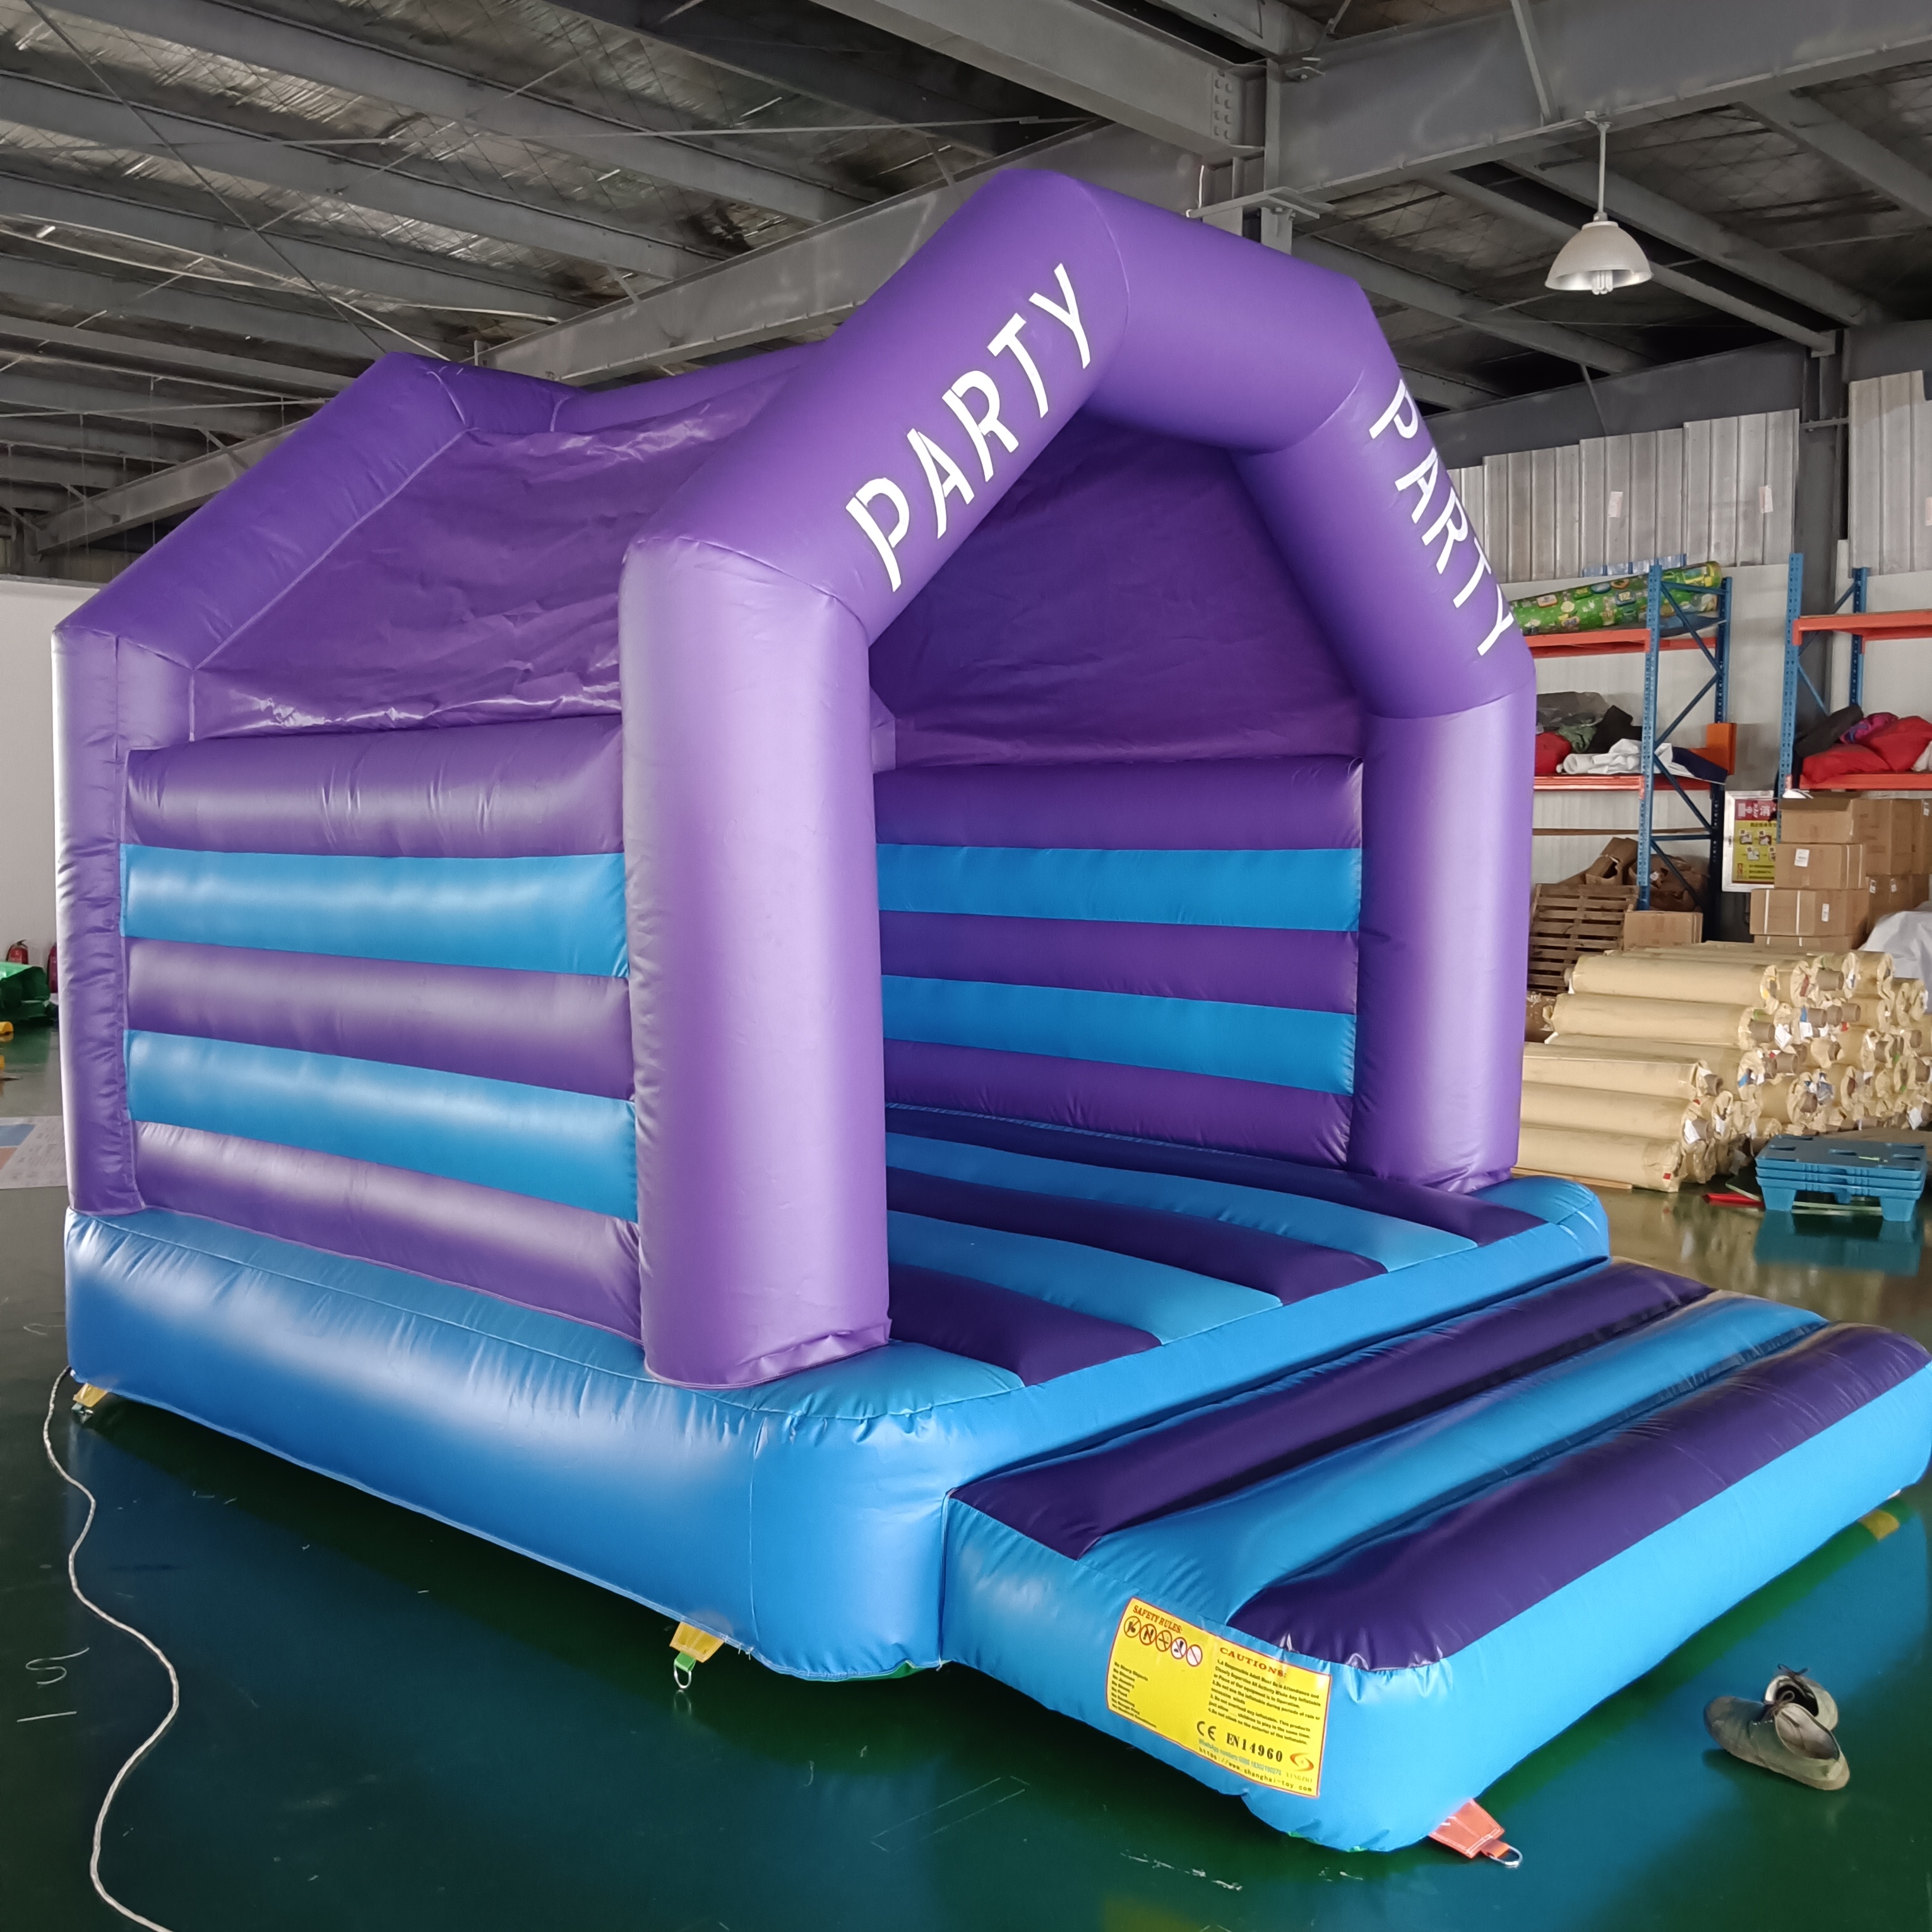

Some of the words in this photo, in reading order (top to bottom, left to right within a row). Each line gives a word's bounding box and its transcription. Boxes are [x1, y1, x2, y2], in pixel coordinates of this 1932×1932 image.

[846, 263, 1090, 592] PARTY
[1369, 379, 1514, 655] PARTY
[1133, 1605, 1160, 1623] SAFETY
